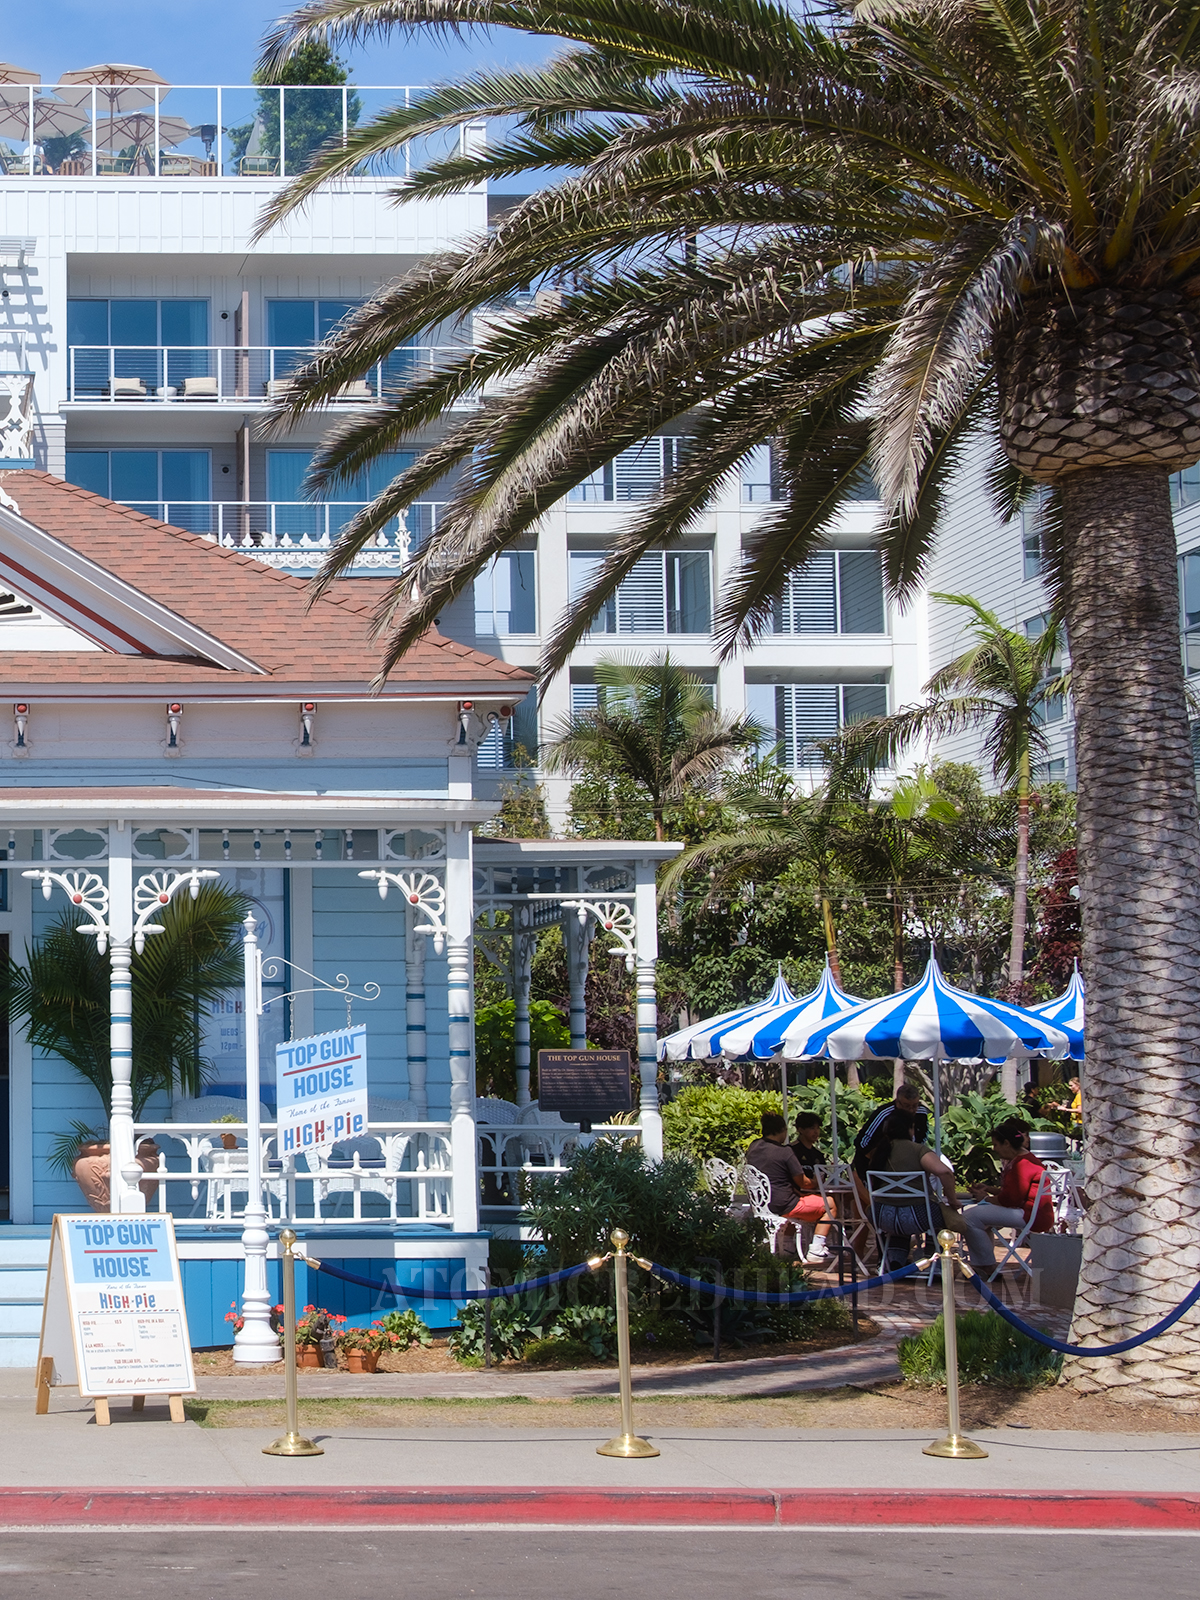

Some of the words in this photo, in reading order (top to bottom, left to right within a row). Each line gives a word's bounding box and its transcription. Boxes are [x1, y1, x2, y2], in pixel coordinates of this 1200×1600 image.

[276, 1043, 317, 1069] TOP
[320, 1031, 366, 1061] GUN
[294, 1065, 353, 1099] HOUSE
[309, 1104, 317, 1113] of
[319, 1101, 330, 1110] the
[75, 1225, 114, 1246] TOP
[117, 1224, 161, 1245] GUN
[93, 1257, 151, 1278] HOUSE
